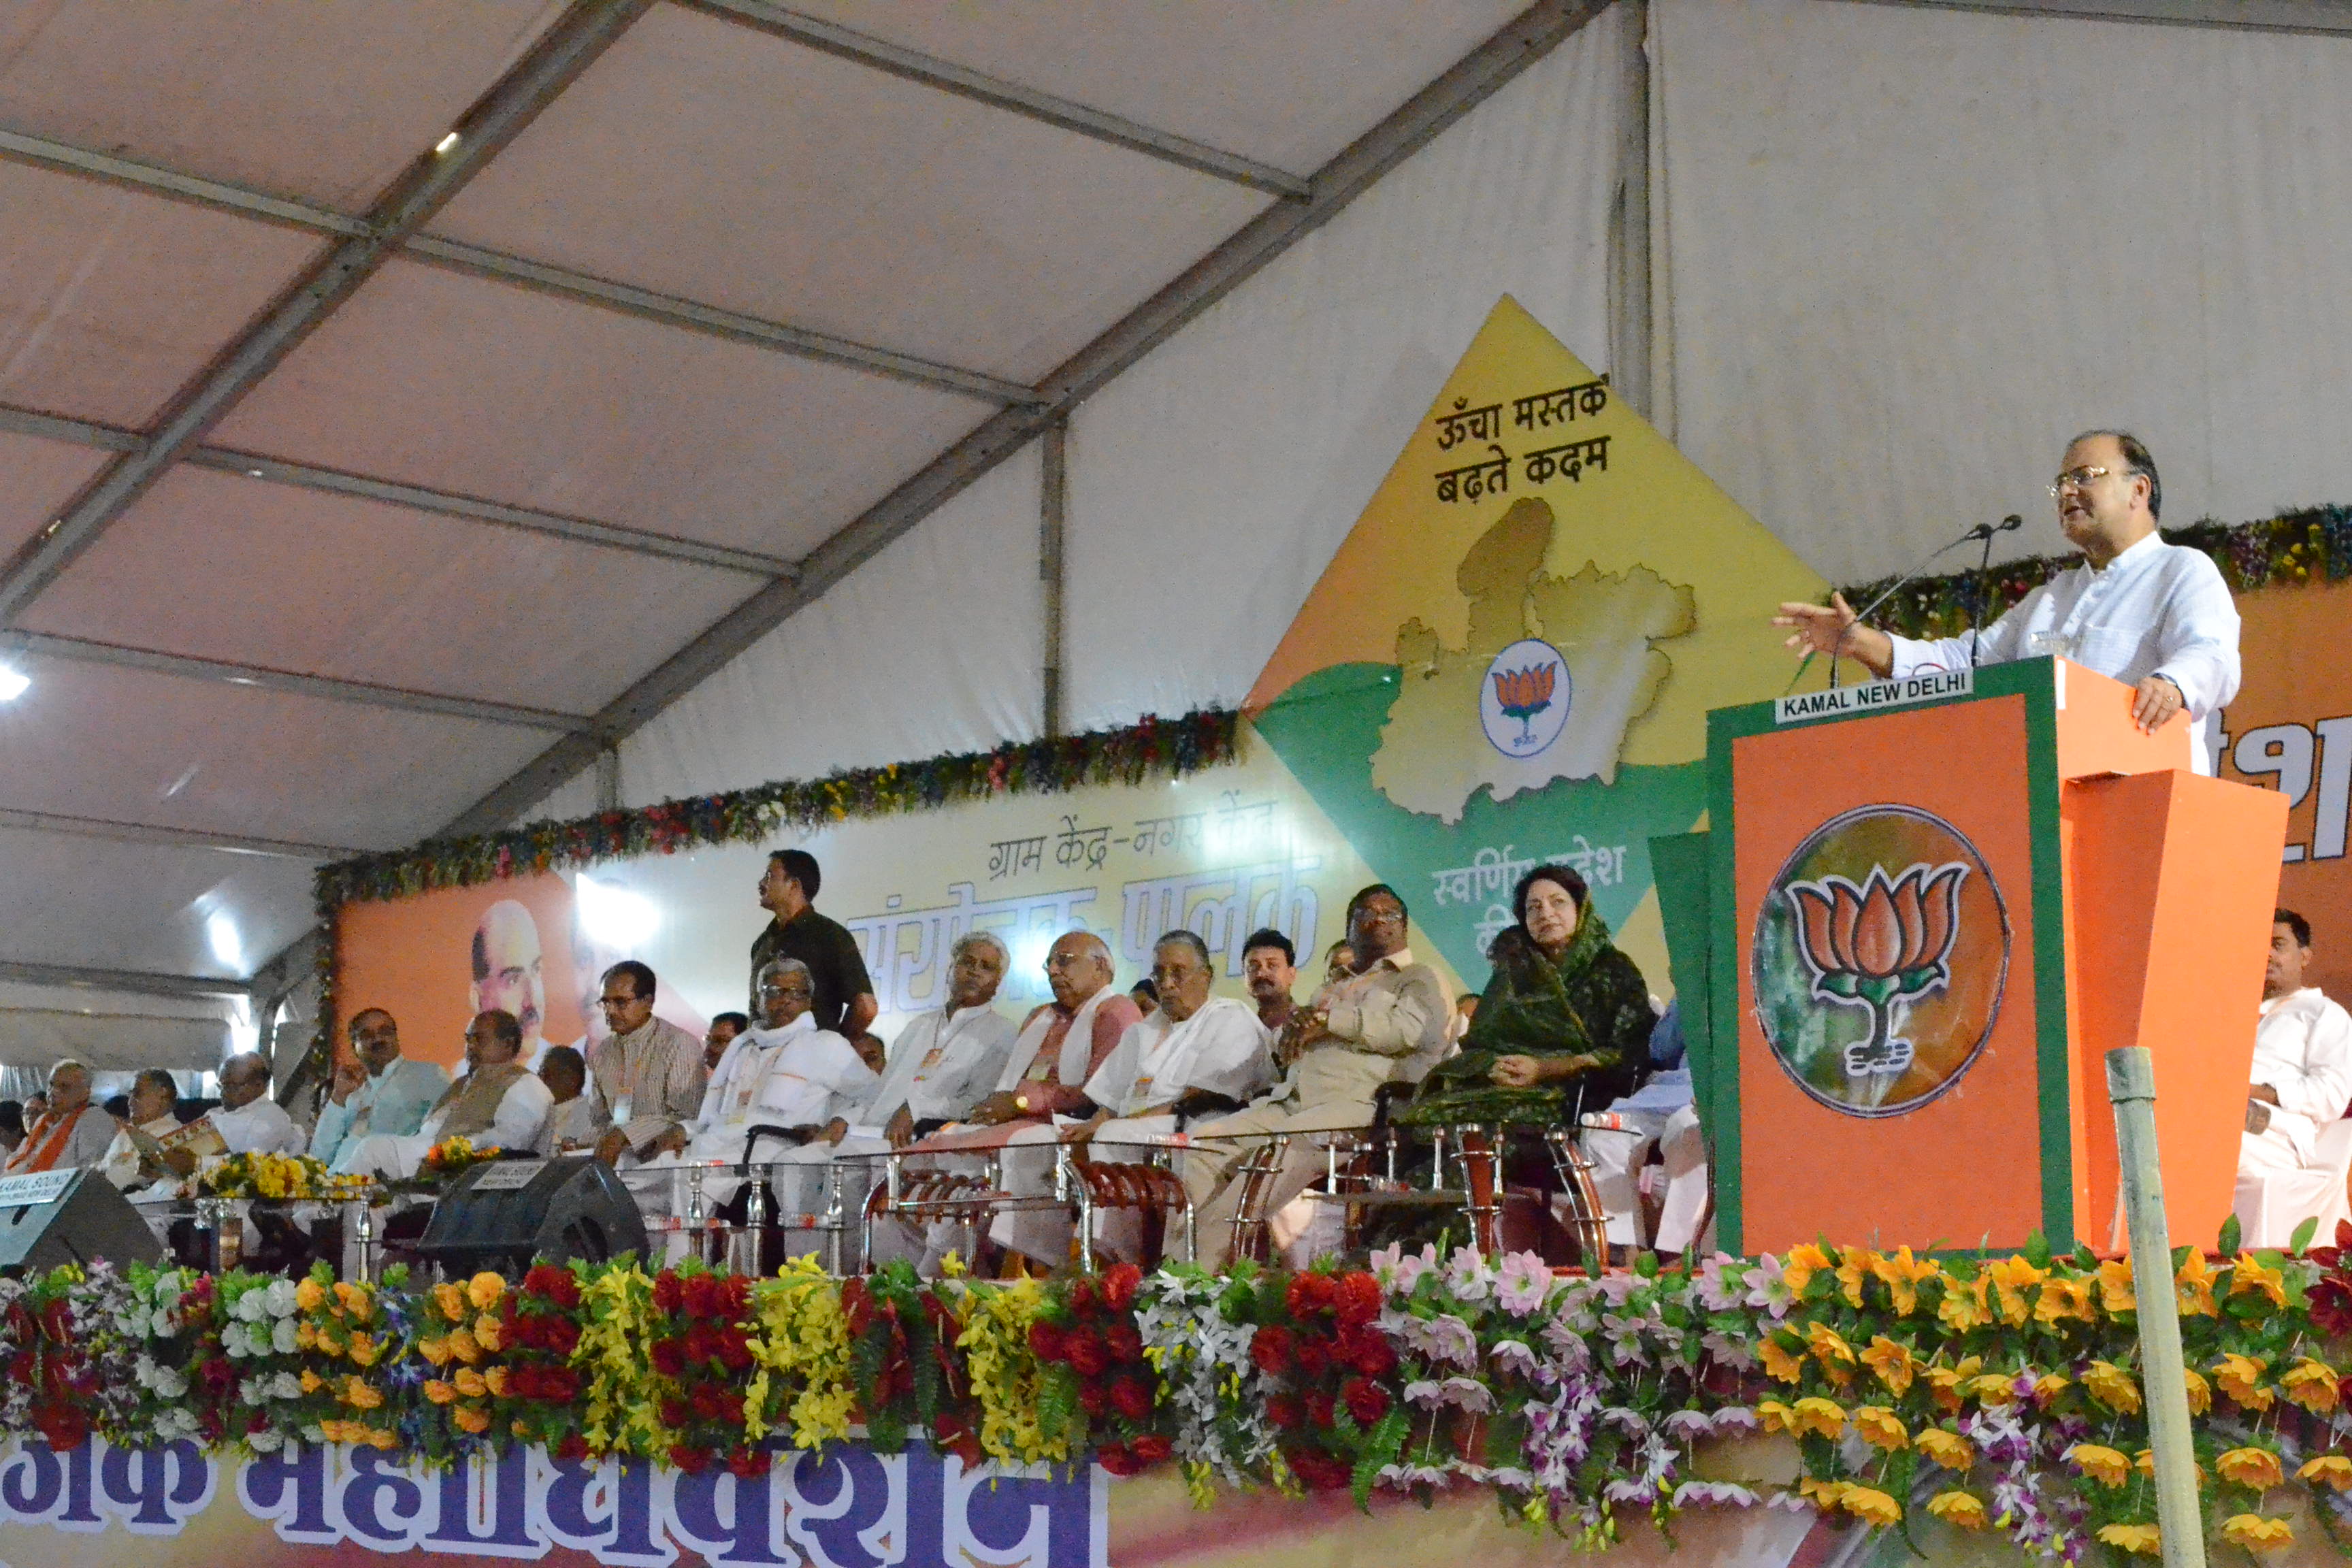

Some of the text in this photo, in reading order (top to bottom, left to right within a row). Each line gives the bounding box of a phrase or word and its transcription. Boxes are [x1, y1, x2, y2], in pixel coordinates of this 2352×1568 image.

[1513, 373, 1610, 430] मस्तक
[1435, 435, 1611, 504] बढ़ते कदम
[1784, 672, 1965, 716] KAMAL NEW DELHI
[989, 836, 1048, 880] ग्राम
